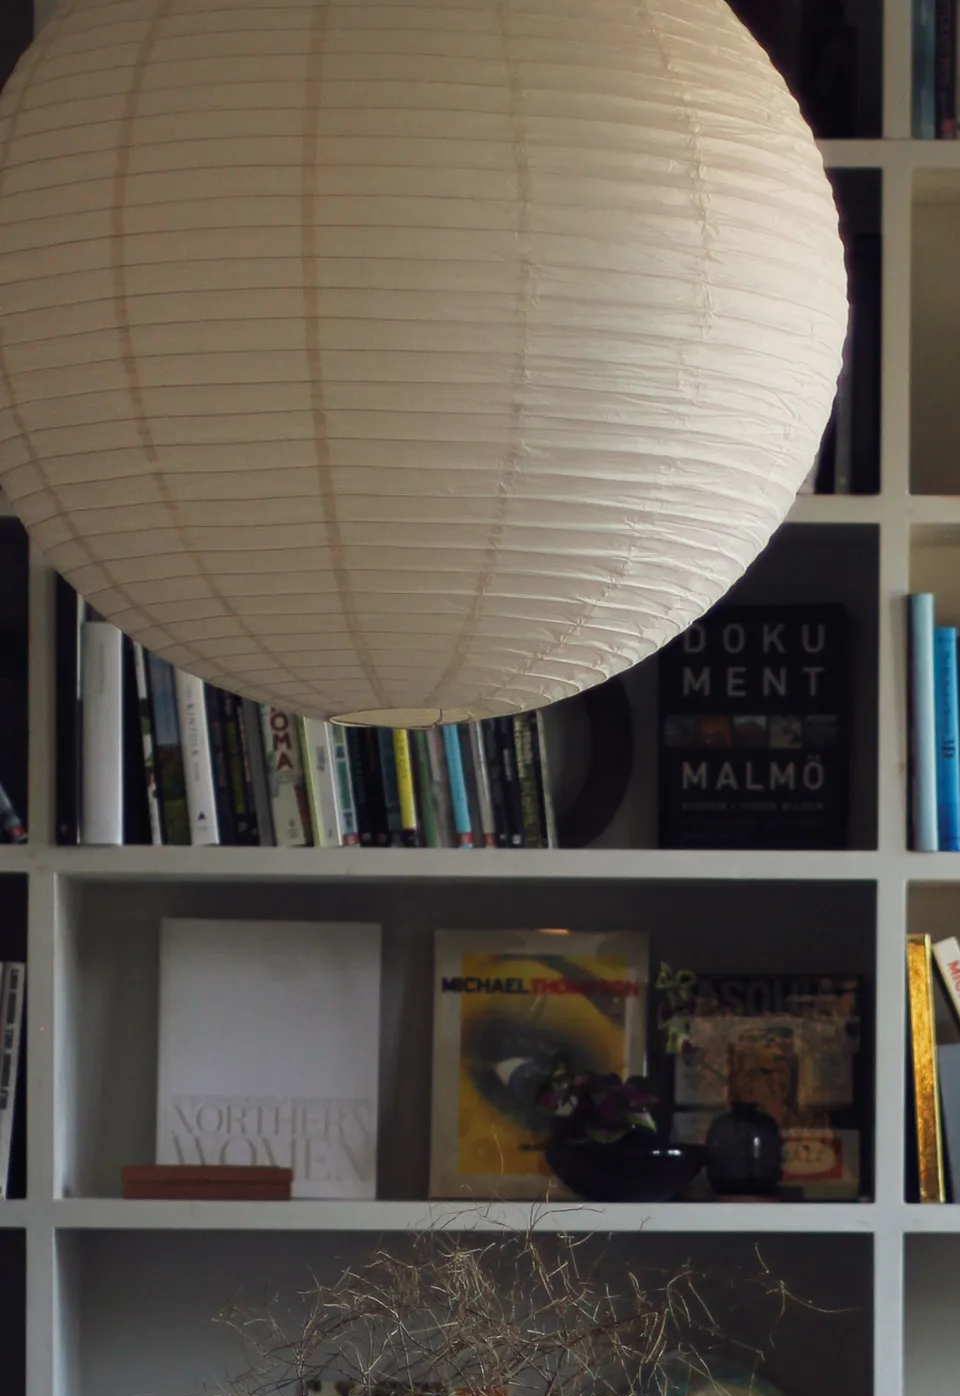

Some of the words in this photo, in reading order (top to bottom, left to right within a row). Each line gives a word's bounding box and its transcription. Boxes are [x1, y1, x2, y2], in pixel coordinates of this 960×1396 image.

[683, 623, 826, 654] DOKU
[682, 666, 825, 697] MENT
[185, 703, 199, 758] KINFOLK
[271, 707, 293, 770] OMA
[681, 755, 825, 790] MALMÖ
[442, 977, 528, 994] MICHAEL
[171, 1102, 374, 1137] NORTHERN
